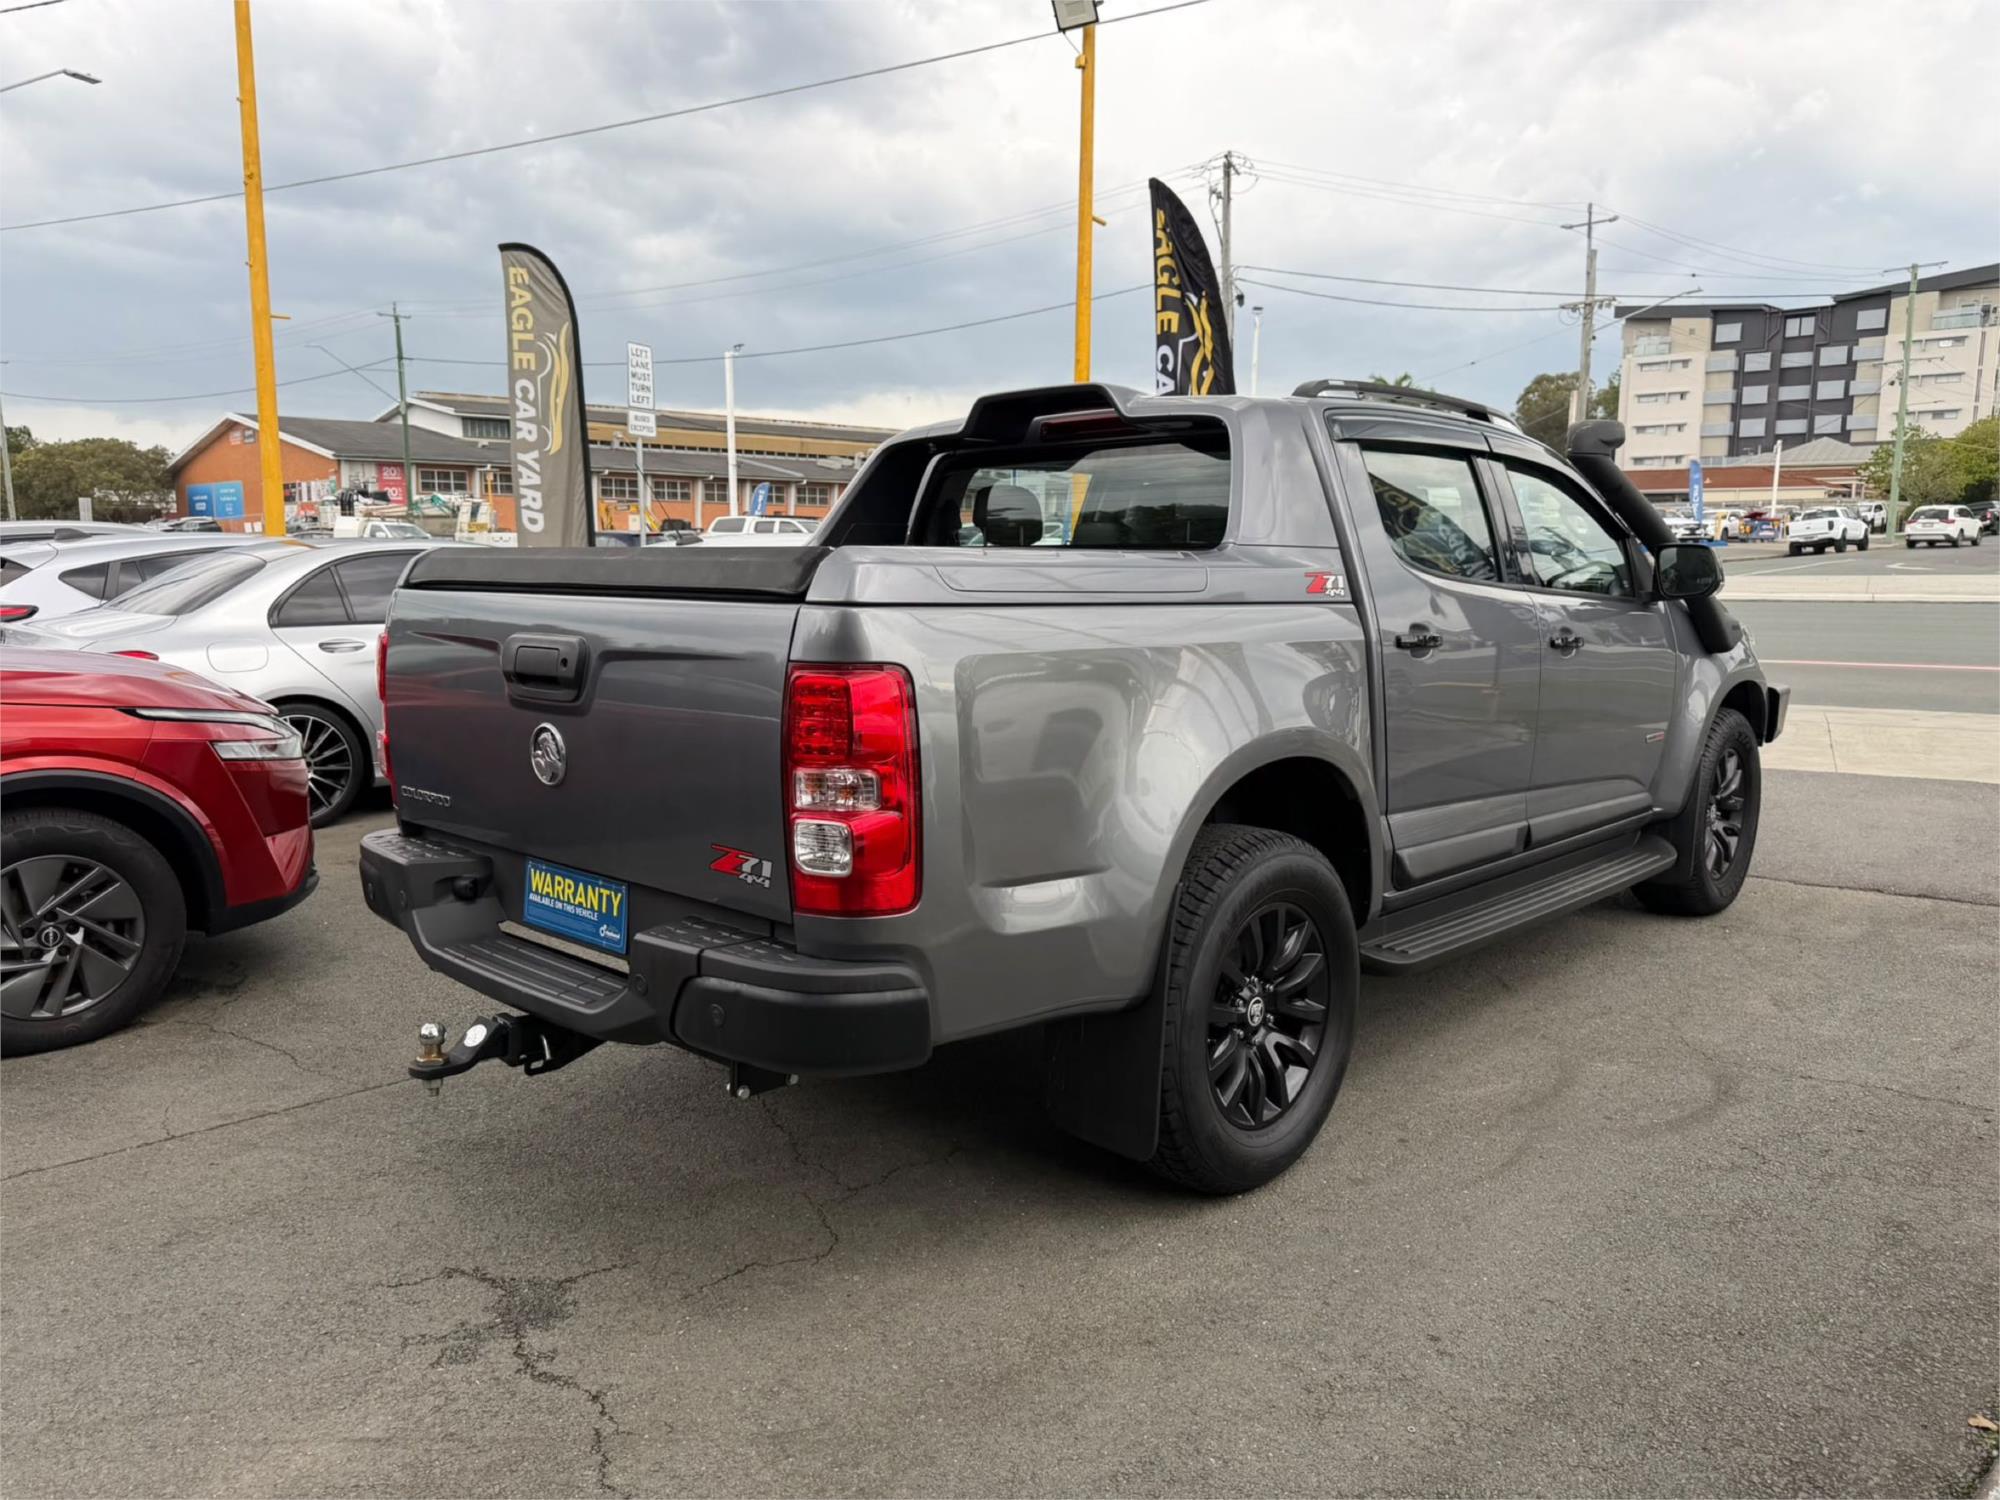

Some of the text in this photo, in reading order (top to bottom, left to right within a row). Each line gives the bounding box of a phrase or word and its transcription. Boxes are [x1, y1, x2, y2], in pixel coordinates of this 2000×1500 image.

[631, 346, 649, 359] LEFT
[631, 358, 650, 370] LANE
[1157, 344, 1175, 396] CA
[631, 371, 651, 382] MUST
[631, 383, 651, 393] TURN
[632, 394, 650, 404] LEFT
[508, 266, 545, 533] EAGLE CAR YARD
[1304, 571, 1345, 593] Z71
[710, 844, 772, 877] Z71
[531, 868, 622, 917] WARRANTY
[529, 892, 599, 921] AVAILABLE ON THIS VEHICLE
